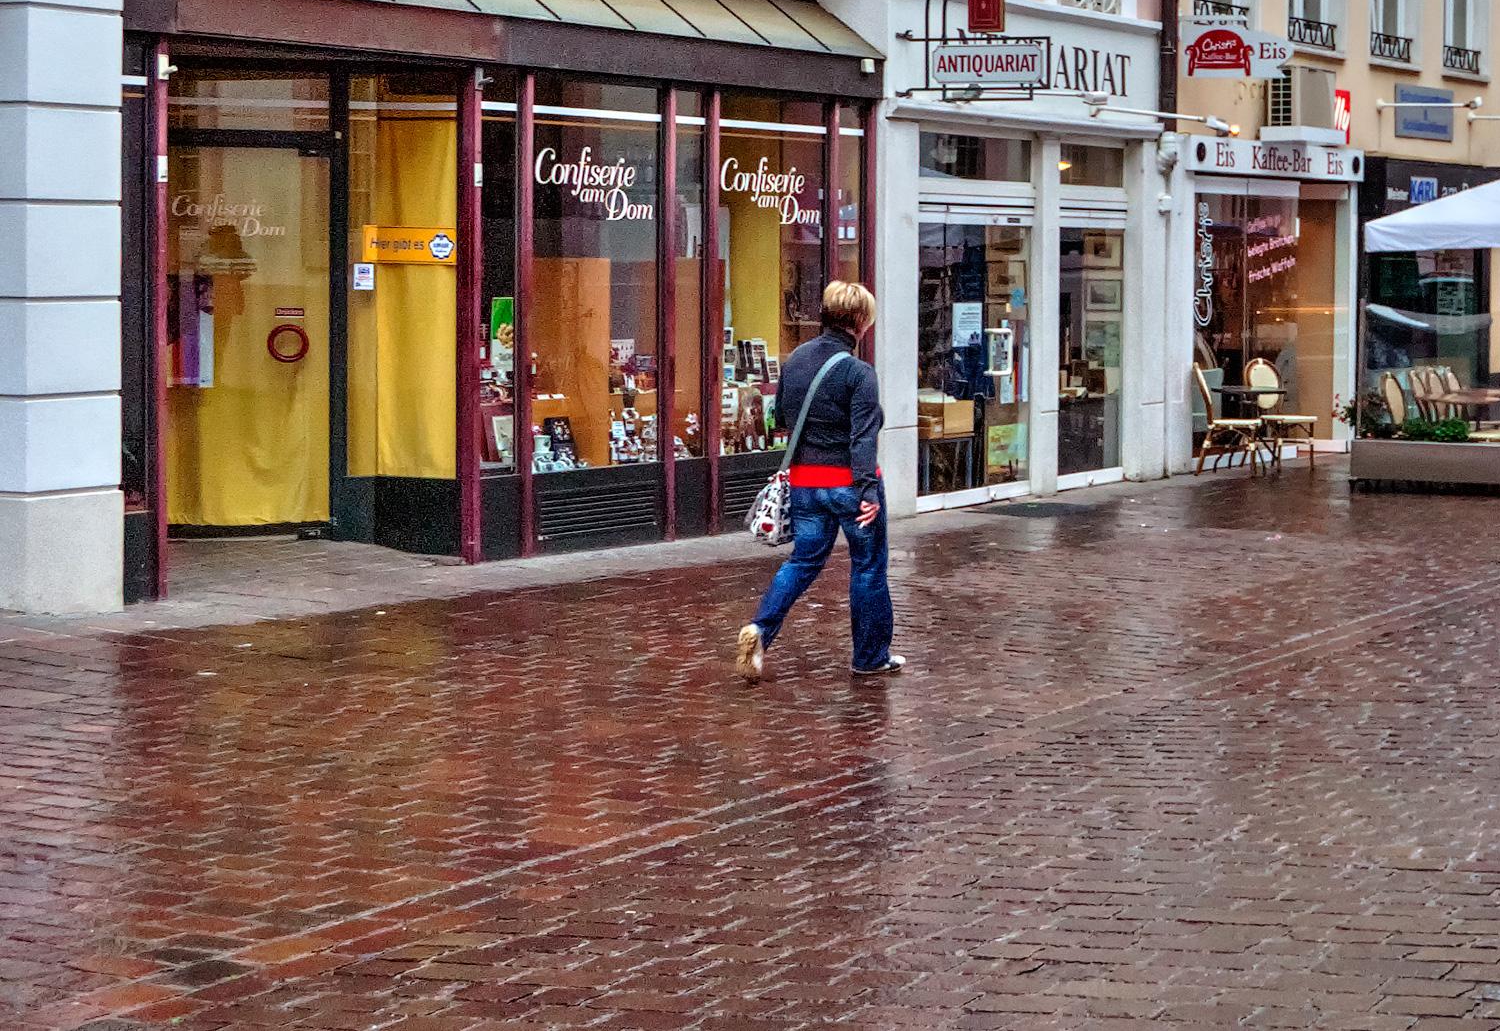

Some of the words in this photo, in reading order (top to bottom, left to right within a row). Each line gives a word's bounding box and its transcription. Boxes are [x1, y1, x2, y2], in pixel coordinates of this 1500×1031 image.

[937, 53, 1038, 77] ANTIQUARIAT
[1259, 42, 1287, 60] Eis
[1334, 96, 1351, 131] lly
[535, 146, 636, 196] Confiserie
[1216, 142, 1236, 168] Eis
[1252, 145, 1312, 173] Kaffee-Bar
[1327, 152, 1344, 175] Eis
[720, 156, 806, 202] Confiserie
[579, 188, 605, 203] am
[605, 187, 653, 221] Dom
[757, 194, 779, 208] am
[779, 194, 820, 225] Dom
[240, 216, 287, 238] Dom
